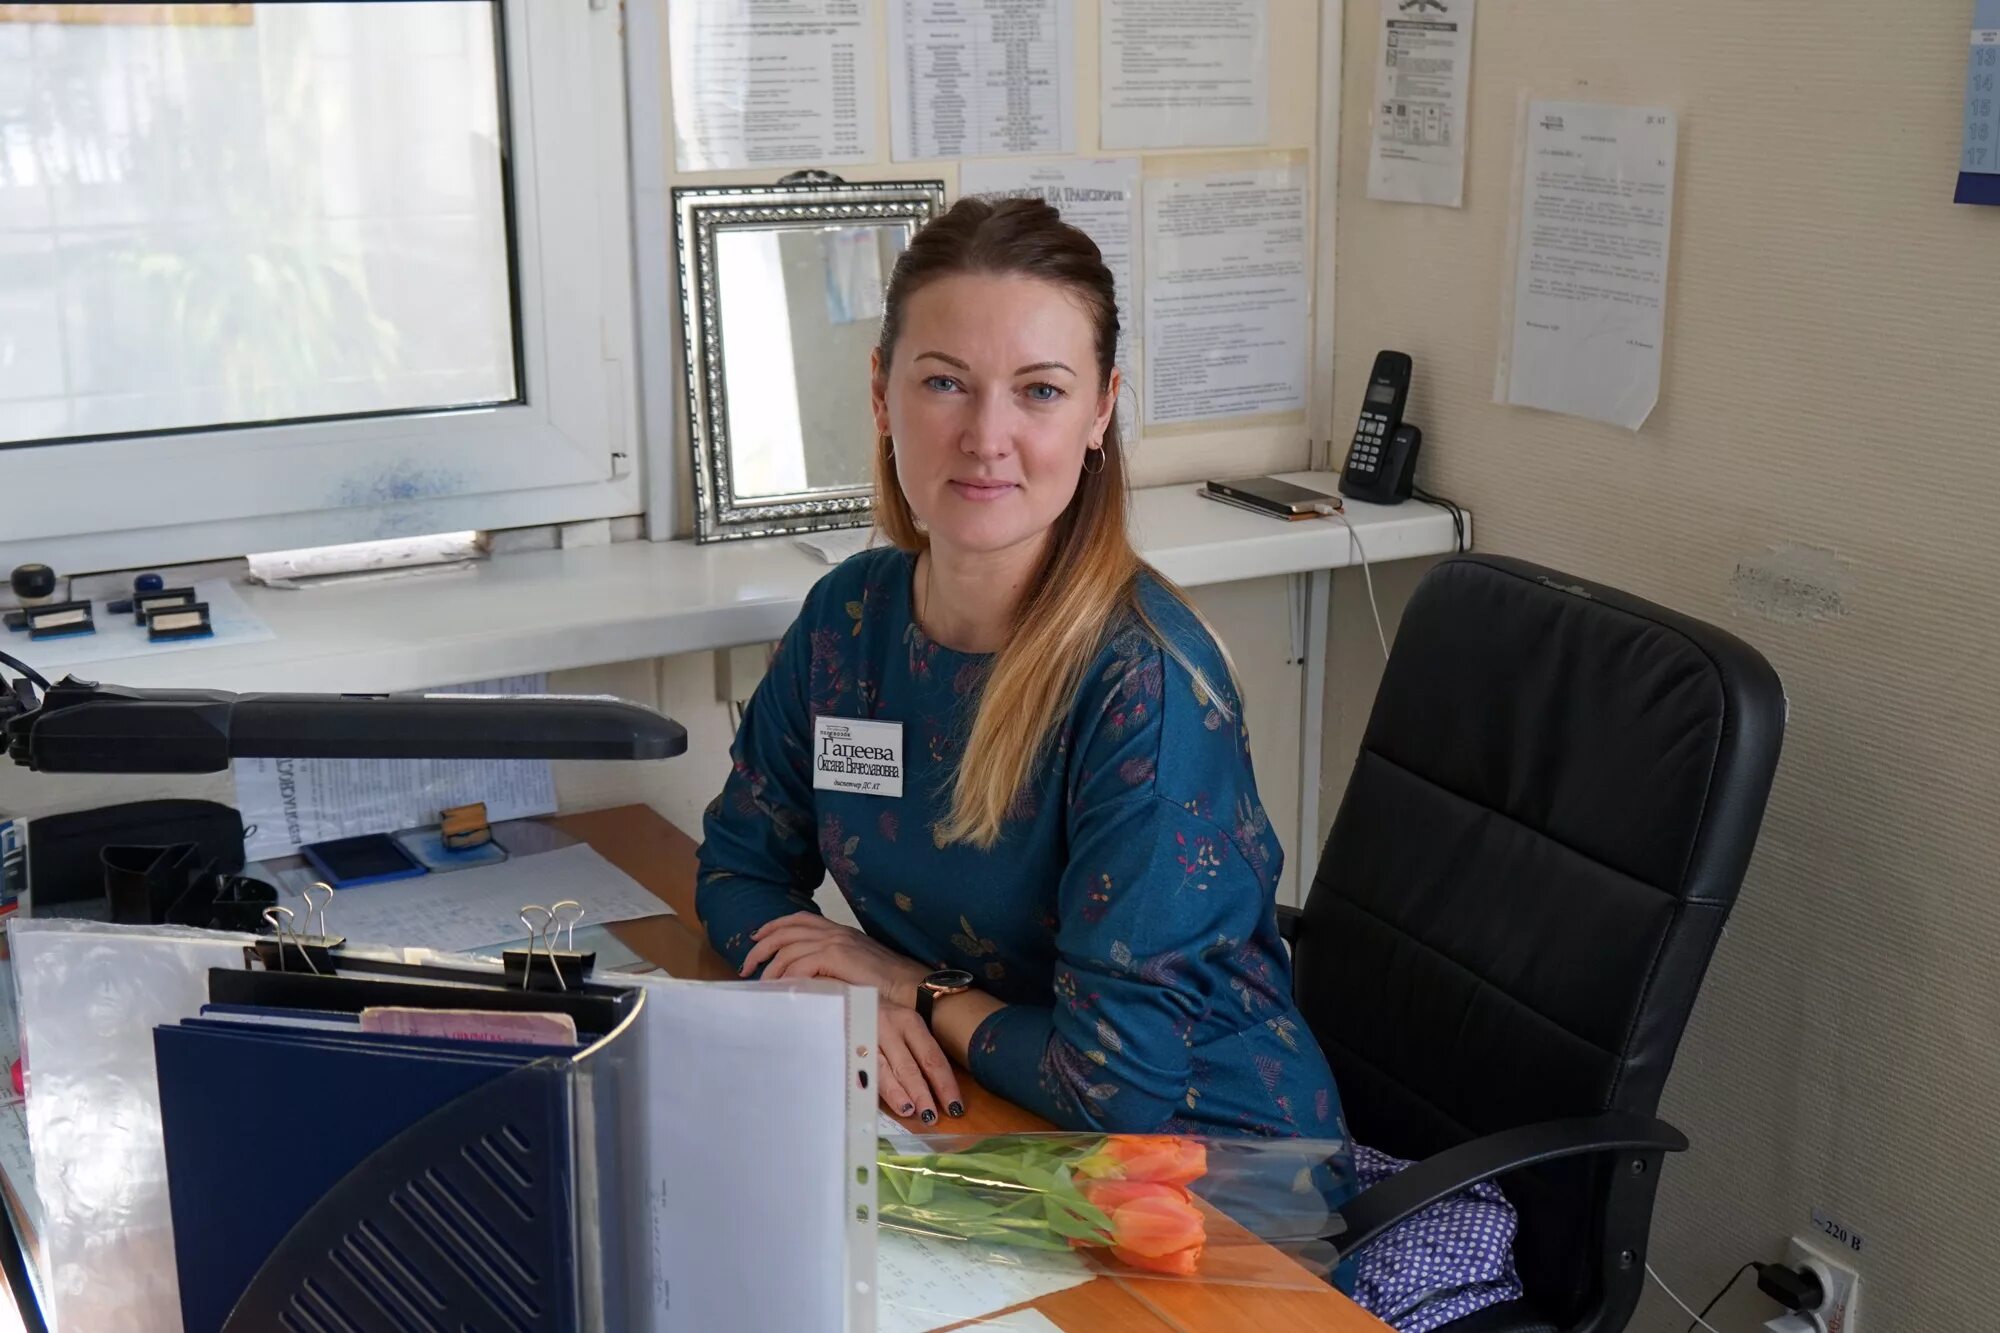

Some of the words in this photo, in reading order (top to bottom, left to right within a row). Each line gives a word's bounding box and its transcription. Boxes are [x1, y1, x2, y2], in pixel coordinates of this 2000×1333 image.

[1977, 48, 1996, 66] 13
[1973, 74, 1993, 92] 14
[1971, 99, 1991, 117] 15
[1969, 123, 1989, 141] 16
[1968, 148, 1987, 165] 17
[822, 737, 894, 761] Гапеева
[817, 754, 845, 773] Оксана
[846, 757, 899, 778] Вячеславовна
[834, 780, 862, 790] диспетчер
